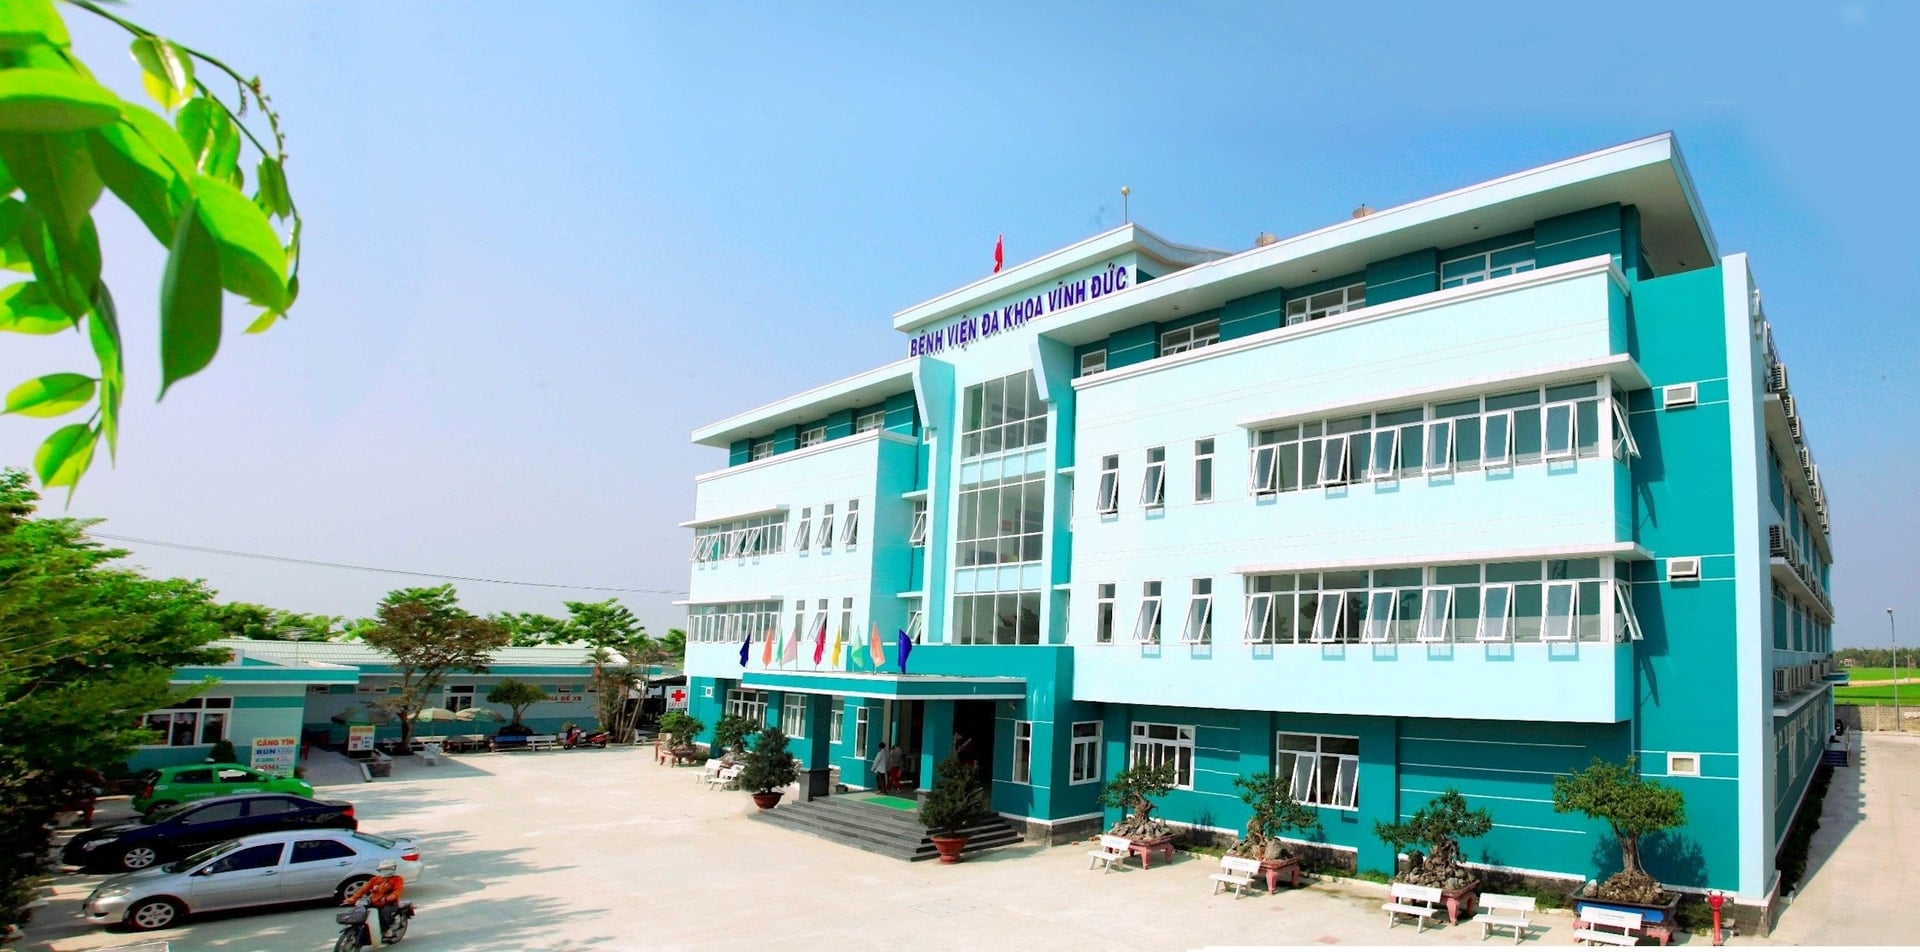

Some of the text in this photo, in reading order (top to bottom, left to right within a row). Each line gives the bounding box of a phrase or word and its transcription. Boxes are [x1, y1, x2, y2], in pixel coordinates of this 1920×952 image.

[947, 314, 977, 349] VIỆN
[982, 310, 999, 337] ĐA
[1003, 295, 1043, 329] KHOA
[1048, 281, 1085, 312] VĨNH
[1091, 262, 1127, 299] ĐỨC
